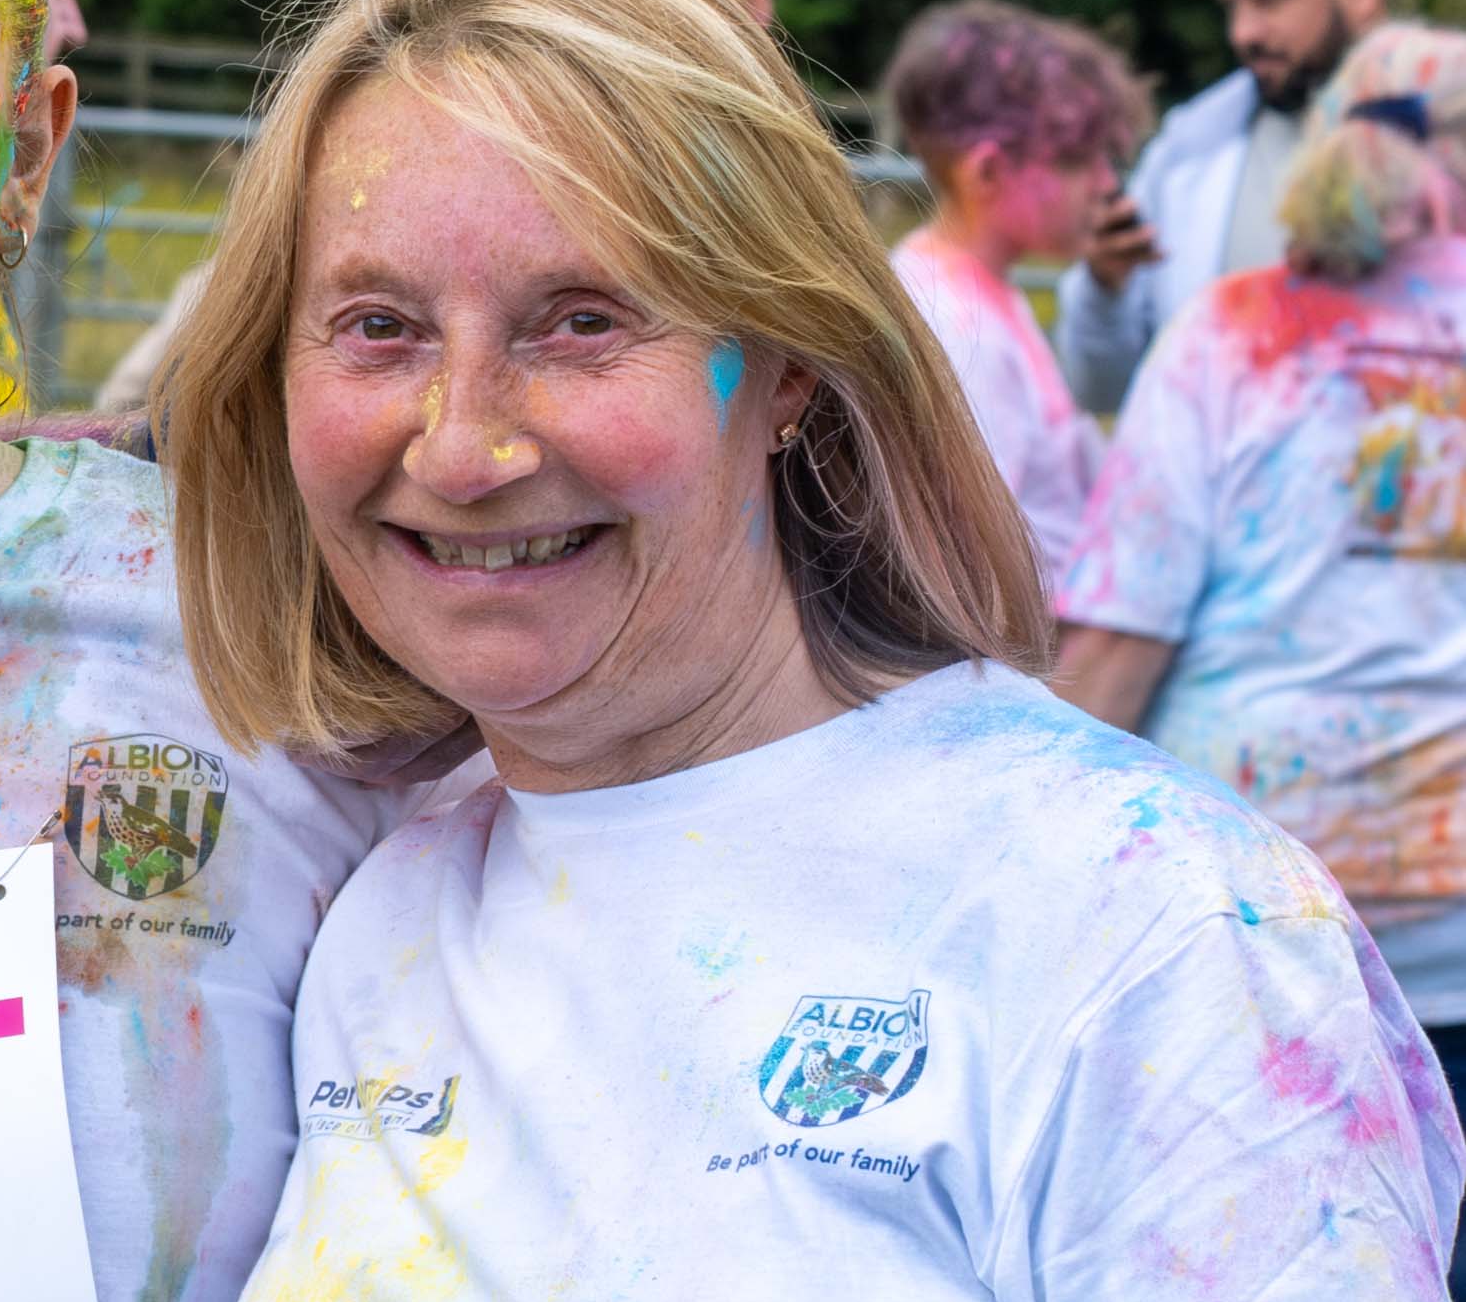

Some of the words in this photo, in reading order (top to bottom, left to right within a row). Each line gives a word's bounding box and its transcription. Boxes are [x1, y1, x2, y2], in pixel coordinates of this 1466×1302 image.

[77, 743, 221, 772] ALBION
[73, 770, 221, 786] FOUNDATION
[56, 911, 103, 931] part
[110, 912, 135, 931] of
[139, 916, 175, 932] our
[180, 918, 236, 946] family
[798, 996, 922, 1037] ALBION
[789, 1024, 922, 1050] FOUNDATION
[309, 1078, 434, 1109] Perps
[706, 1155, 732, 1173] Be
[736, 1143, 769, 1173] part
[774, 1138, 802, 1159] of
[804, 1147, 845, 1164] our
[851, 1148, 921, 1183] family
